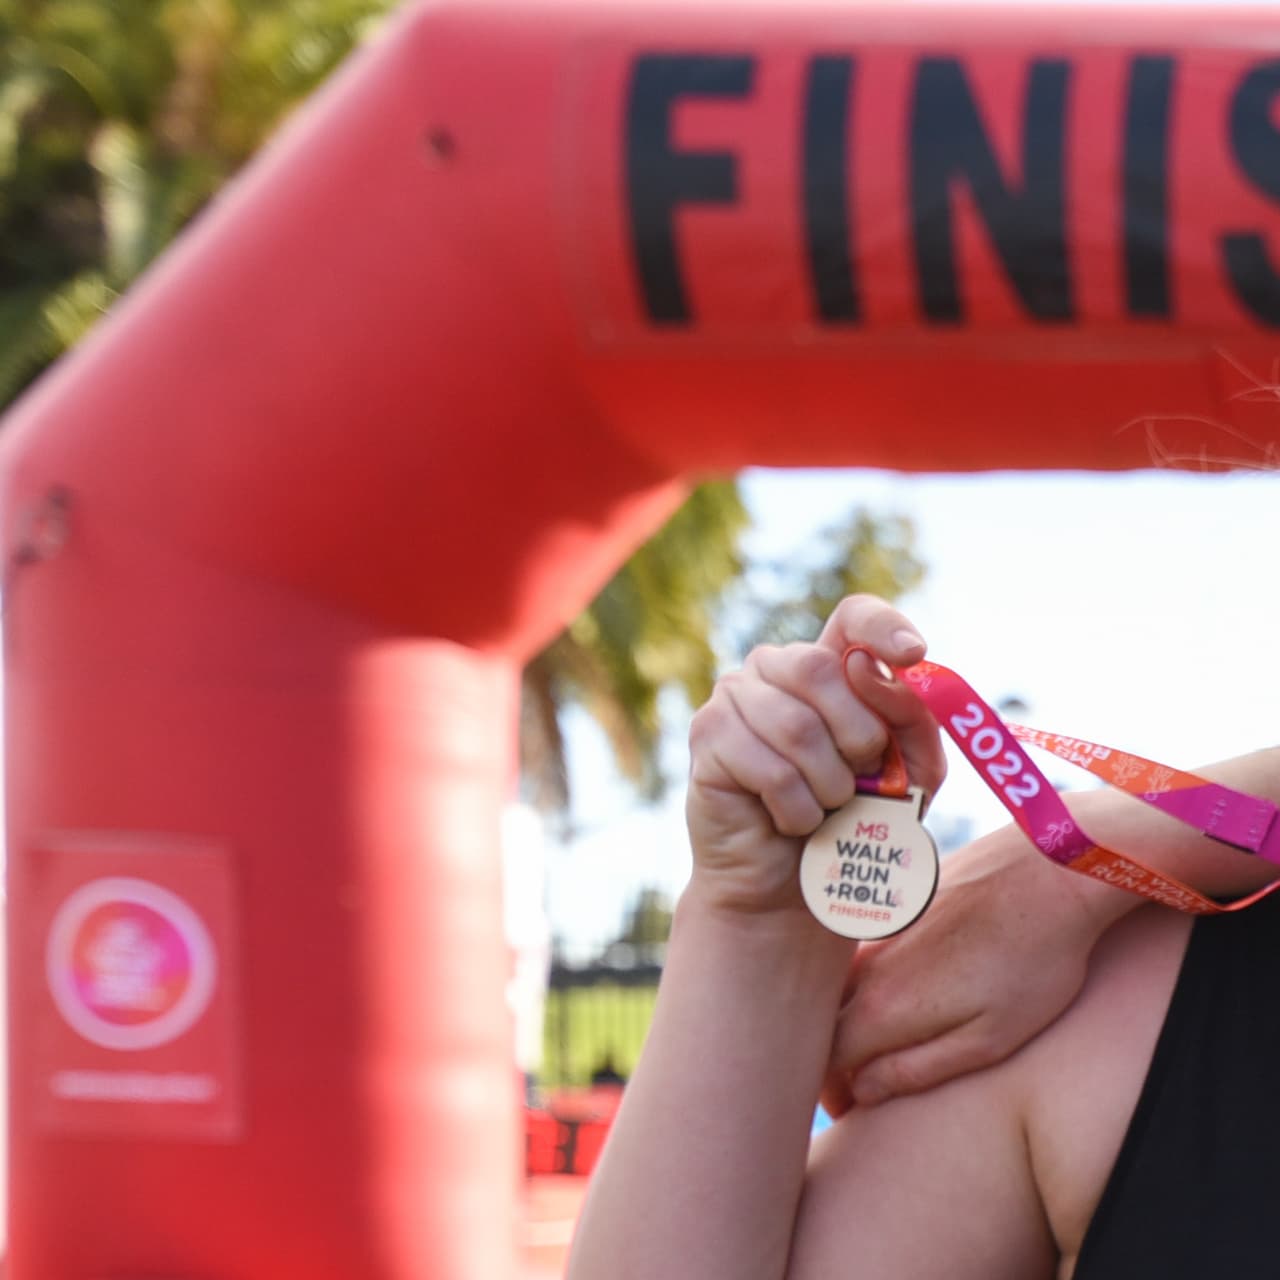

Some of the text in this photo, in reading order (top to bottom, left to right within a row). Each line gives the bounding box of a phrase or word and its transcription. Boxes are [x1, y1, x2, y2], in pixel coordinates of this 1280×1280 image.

[950, 703, 1040, 807] 2022
[855, 821, 889, 841] MS
[836, 839, 904, 867] WALK
[840, 862, 890, 885] RUN
[829, 904, 891, 922] FINISHER
